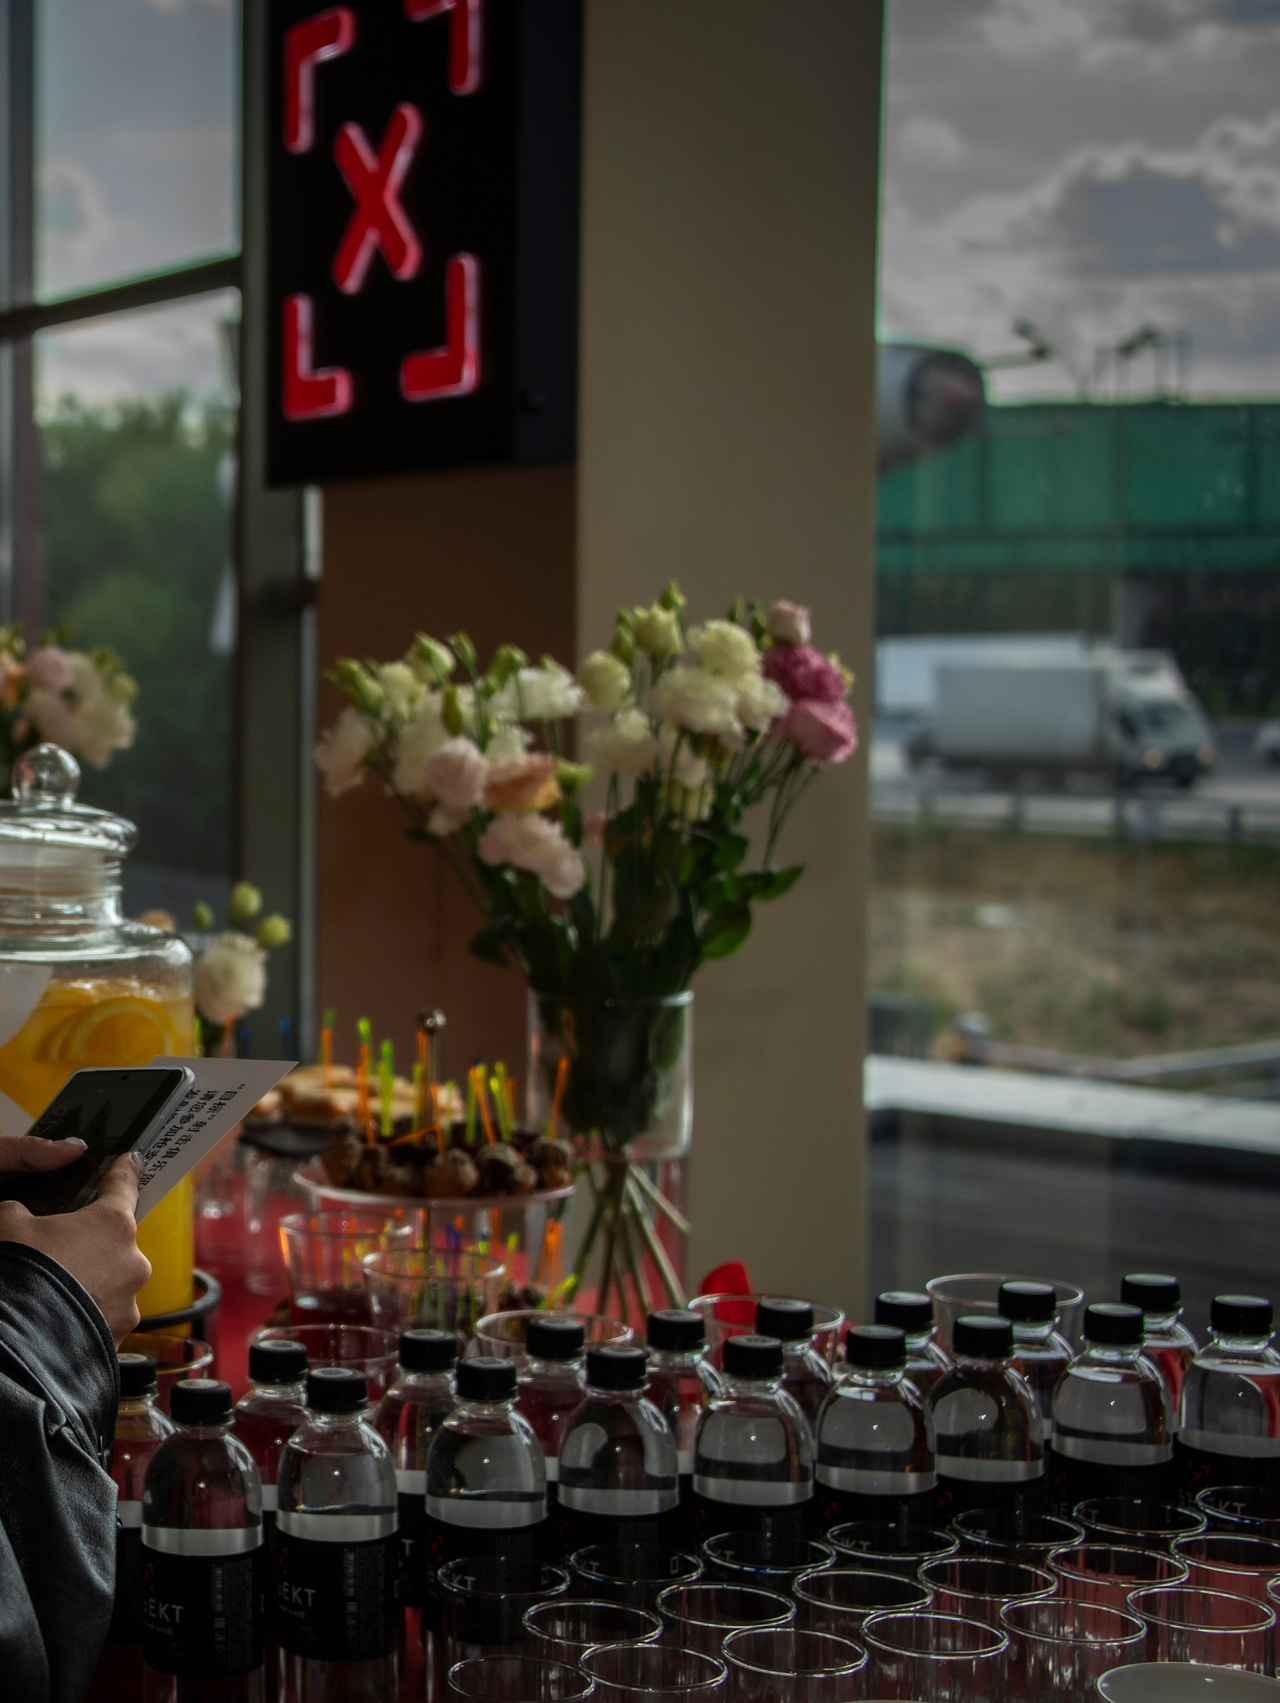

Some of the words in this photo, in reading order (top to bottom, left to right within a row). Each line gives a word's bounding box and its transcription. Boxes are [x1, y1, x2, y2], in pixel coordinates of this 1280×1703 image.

[143, 1089, 220, 1167] 请您参加枪支
